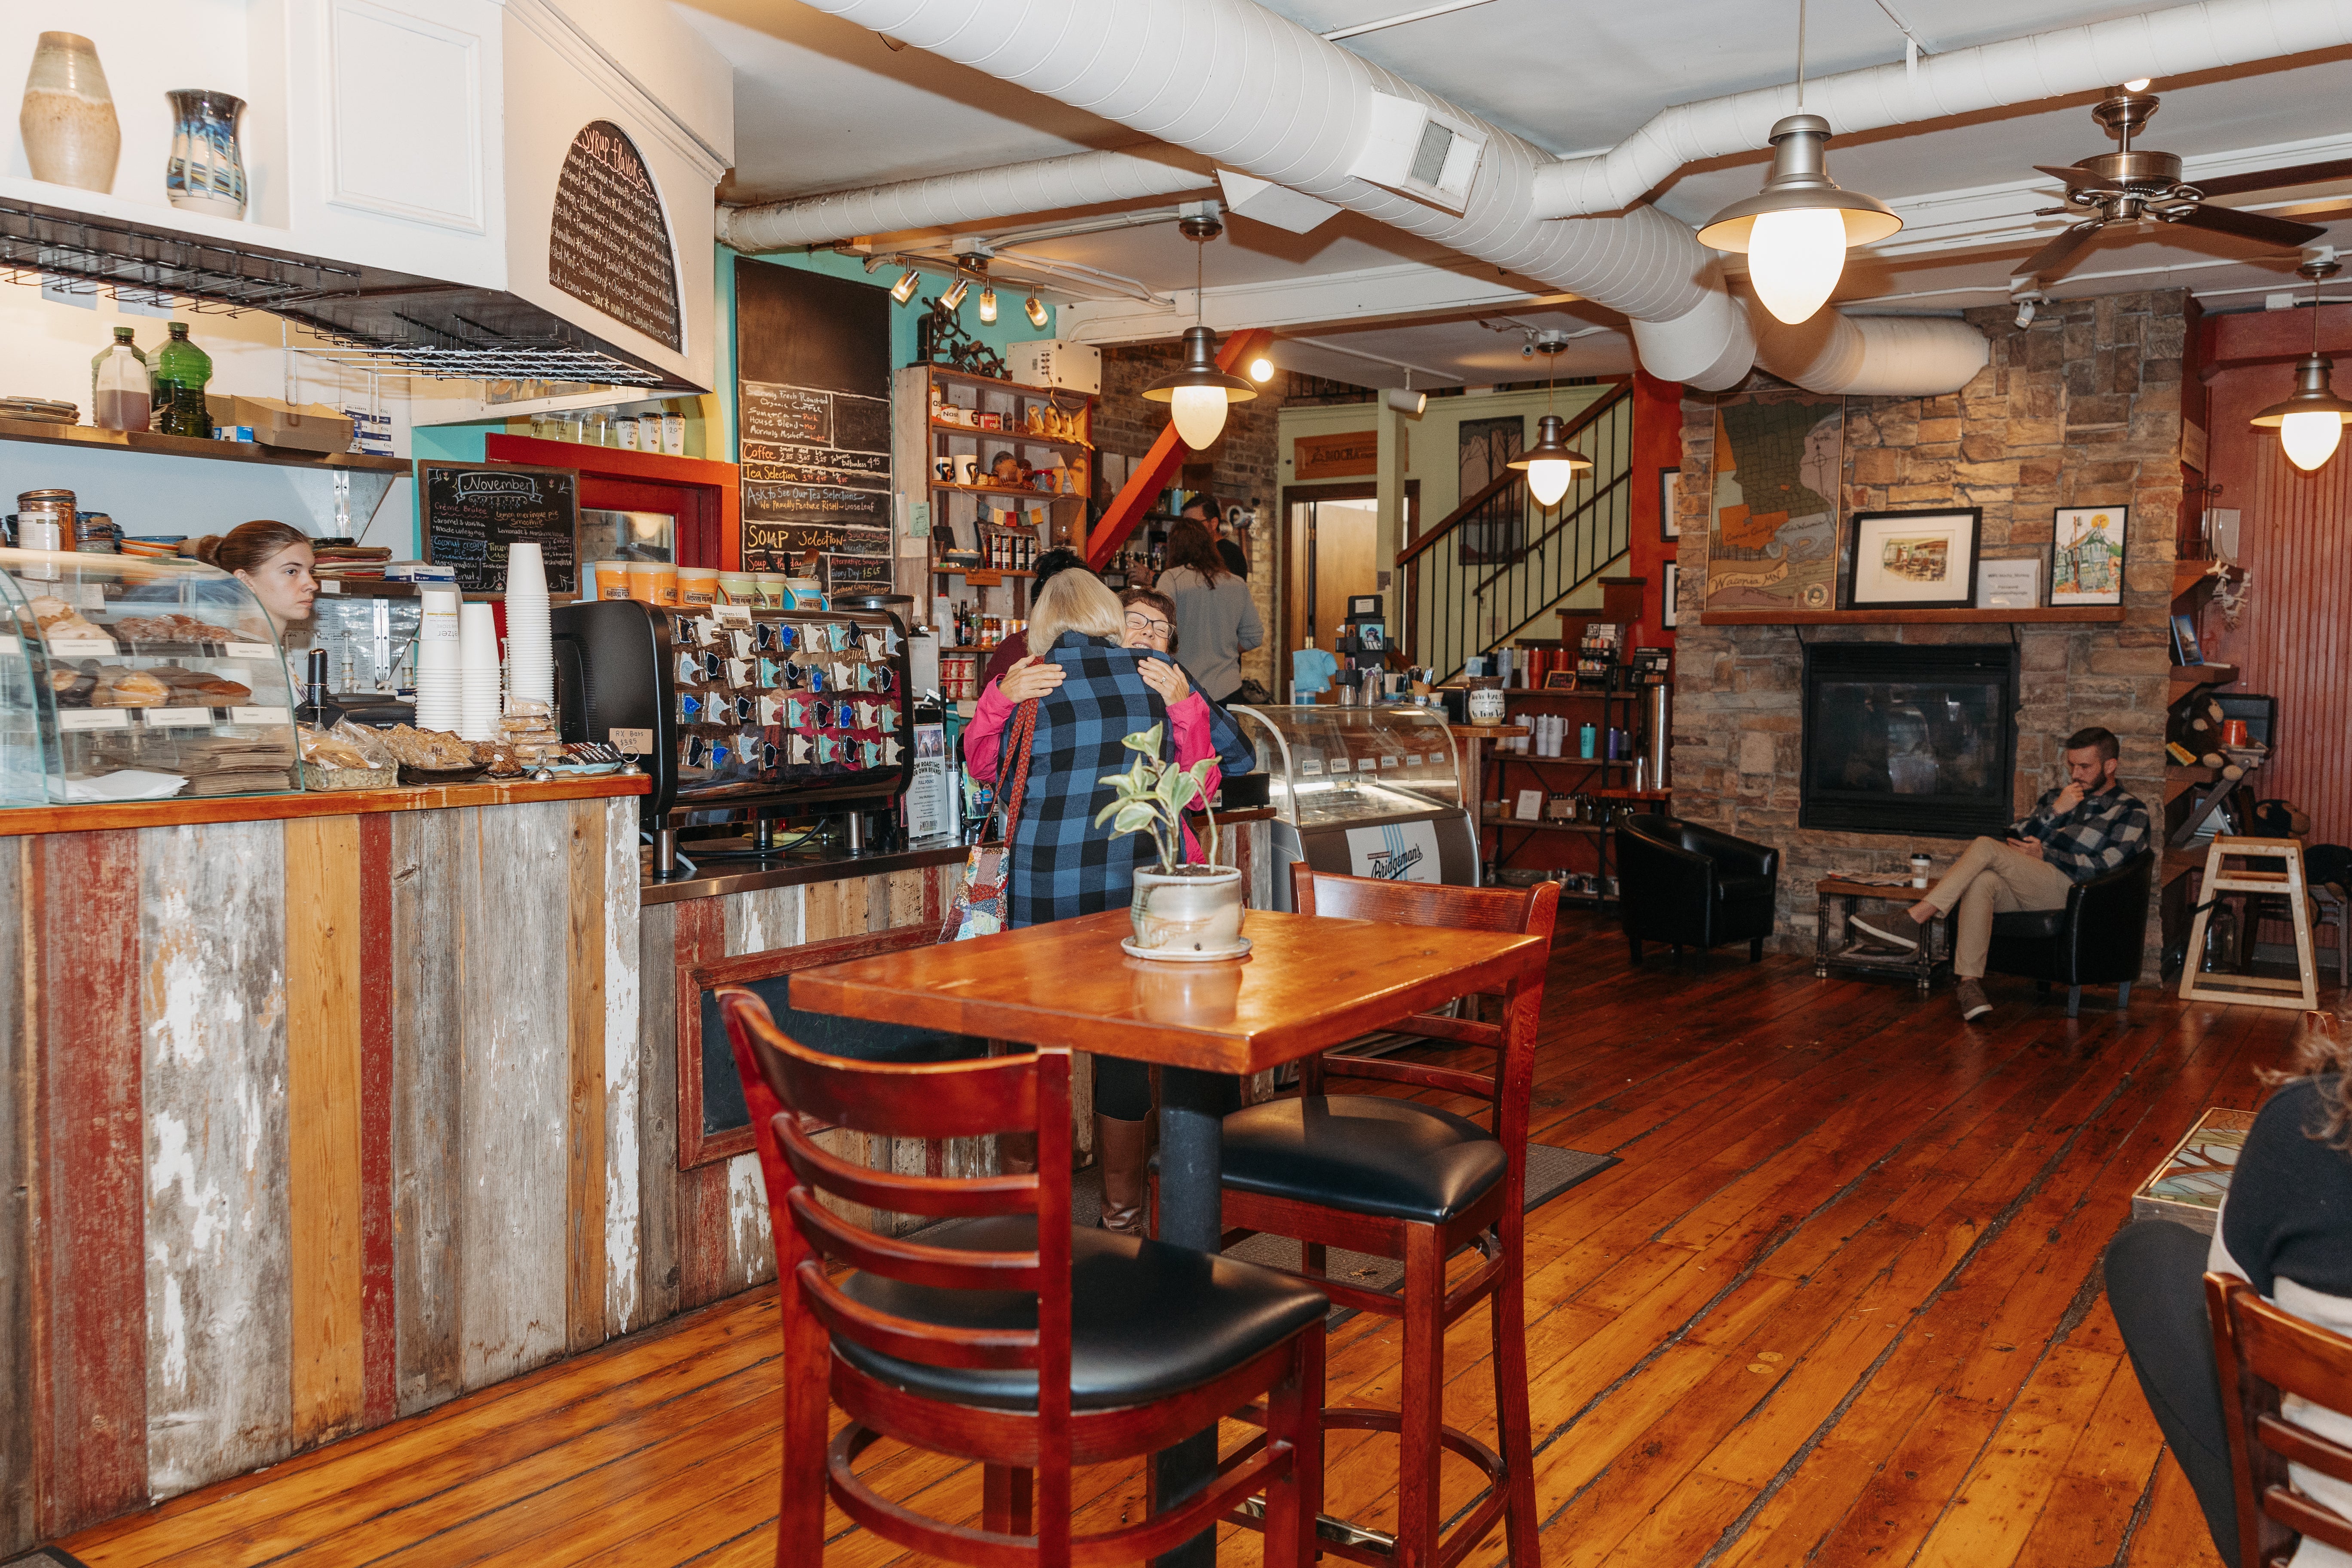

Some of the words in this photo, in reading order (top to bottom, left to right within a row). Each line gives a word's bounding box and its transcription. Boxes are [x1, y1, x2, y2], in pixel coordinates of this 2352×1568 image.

[588, 159, 609, 187] Banana
[632, 191, 647, 212] Cherry
[649, 201, 660, 222] Lime
[561, 167, 581, 189] aramel
[614, 198, 636, 224] Chocolate
[654, 224, 666, 245] Honey
[579, 236, 603, 264] Raspberry
[661, 286, 678, 309] Vanilla
[779, 389, 797, 400] Fresh
[799, 392, 828, 404] Roasted
[749, 416, 774, 426] House
[744, 443, 777, 459] Coffee
[1325, 448, 1360, 461] MOCHA
[743, 463, 763, 479] Tea
[764, 466, 798, 481] Selection
[464, 476, 532, 490] November
[747, 486, 769, 507] Ask
[768, 486, 776, 500] to
[777, 487, 790, 498] See
[793, 487, 808, 499] Our
[807, 488, 821, 501] Tea
[823, 488, 865, 501] Selections
[760, 500, 770, 509] We
[861, 502, 874, 512] Leaf
[433, 516, 458, 525] Caramel
[548, 510, 559, 519] pie
[434, 536, 460, 547] Coconut
[748, 525, 789, 548] SOUP
[747, 555, 766, 572] Soup
[830, 557, 862, 566] Alternative
[831, 568, 846, 579] Every
[847, 567, 860, 580] Day
[863, 567, 881, 579] $5.65
[832, 585, 853, 595] Cashew
[854, 582, 870, 591] Carrot
[870, 584, 891, 594] Ginger
[620, 738, 637, 746] $3.85
